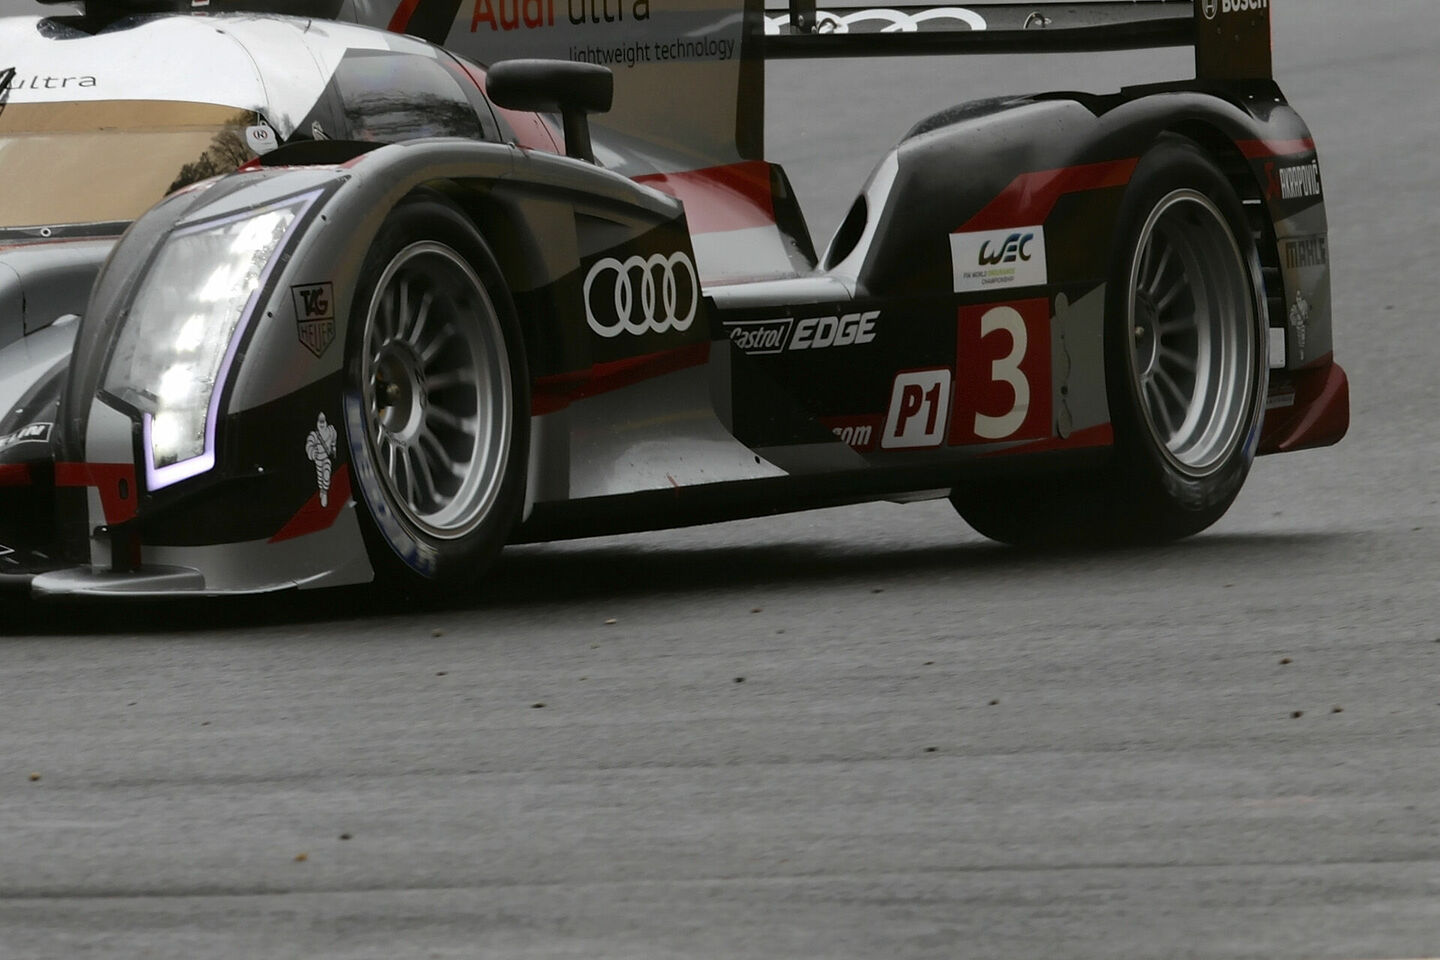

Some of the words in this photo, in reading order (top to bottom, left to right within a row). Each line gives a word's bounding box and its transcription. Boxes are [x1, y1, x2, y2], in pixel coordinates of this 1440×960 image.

[568, 41, 651, 68] lightweight
[655, 35, 735, 61] technology
[9, 75, 97, 90] ultra
[978, 233, 1034, 266] WEC
[1285, 238, 1327, 269] MAHLE
[300, 288, 329, 317] TAG
[730, 325, 785, 349] Castrol
[788, 310, 881, 351] EDGE
[973, 305, 1031, 440] 3
[893, 382, 942, 438] P1
